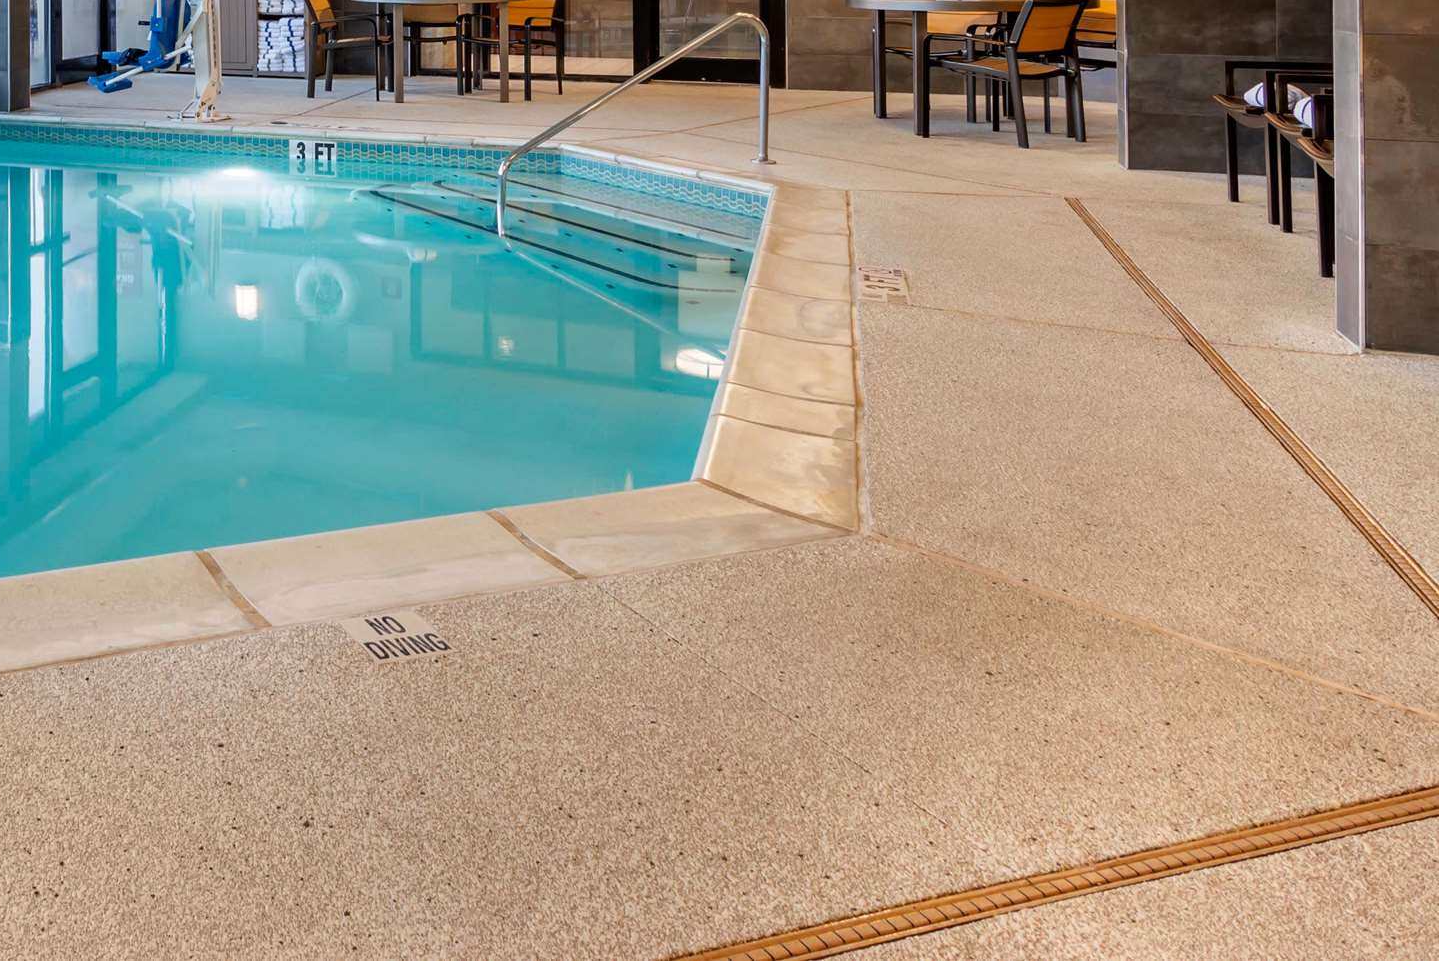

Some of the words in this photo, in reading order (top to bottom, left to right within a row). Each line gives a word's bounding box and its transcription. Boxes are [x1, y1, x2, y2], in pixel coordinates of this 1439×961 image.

[296, 142, 306, 160] 3
[315, 143, 335, 161] FT
[364, 616, 406, 636] NO
[363, 633, 452, 660] DIVING
